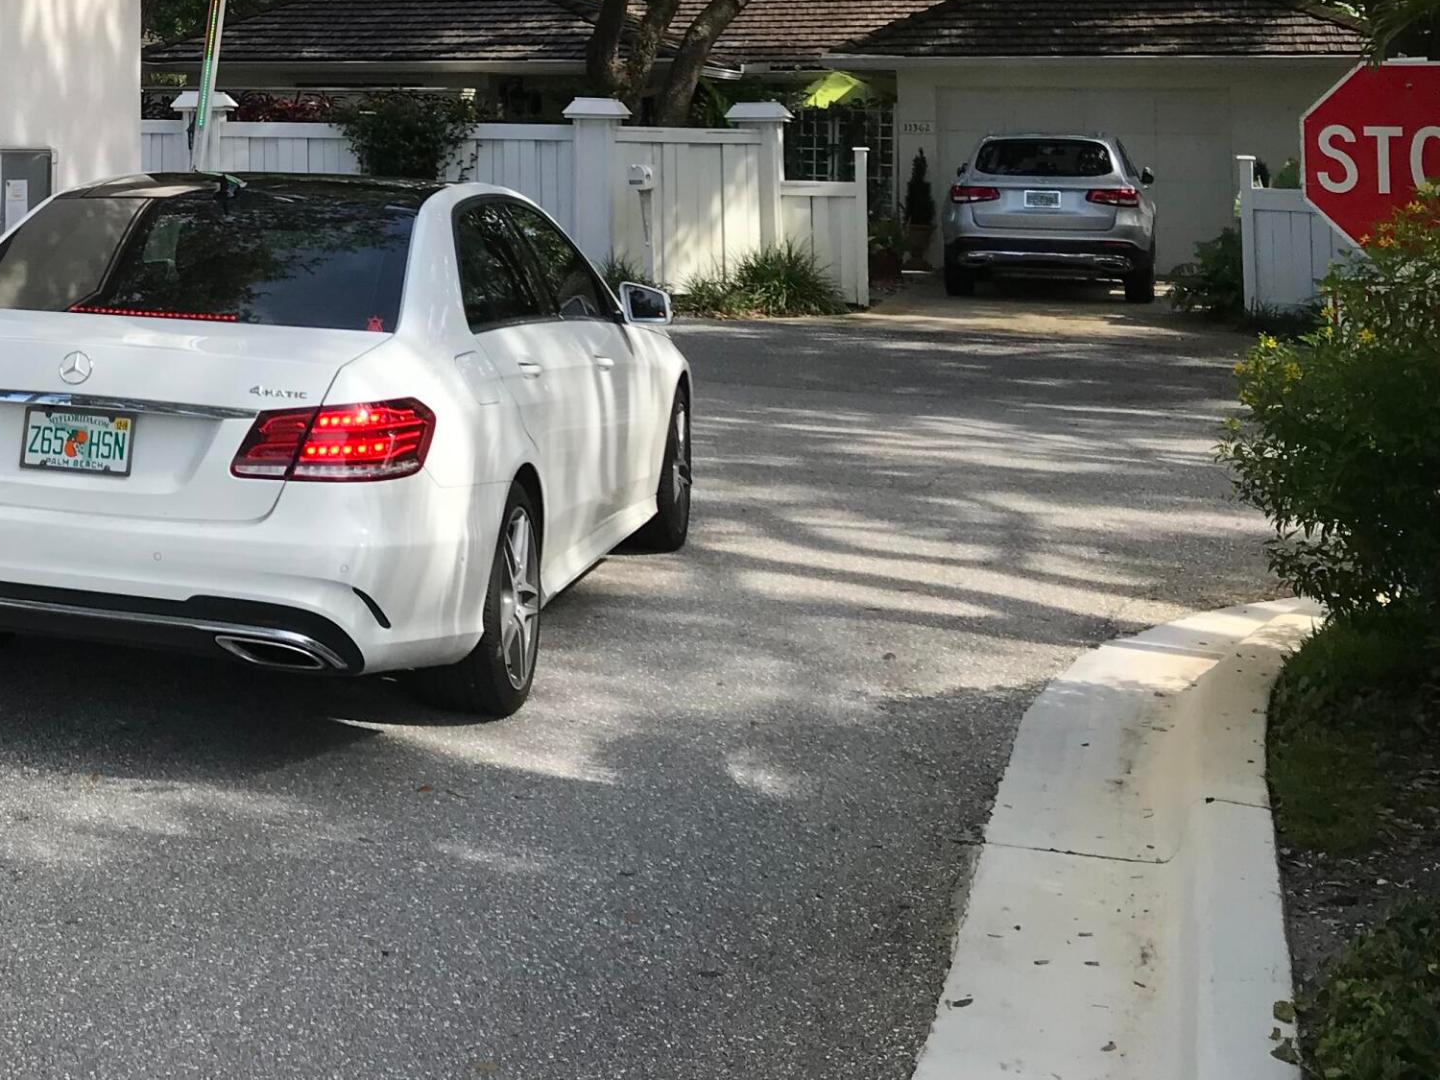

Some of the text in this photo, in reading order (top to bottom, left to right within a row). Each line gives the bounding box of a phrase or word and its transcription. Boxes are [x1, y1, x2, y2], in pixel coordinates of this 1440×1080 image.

[1316, 124, 1440, 195] STO
[249, 385, 308, 399] 4MATIC
[28, 425, 126, 460] Z65 HSN
[45, 457, 103, 468] PALM BEACH
